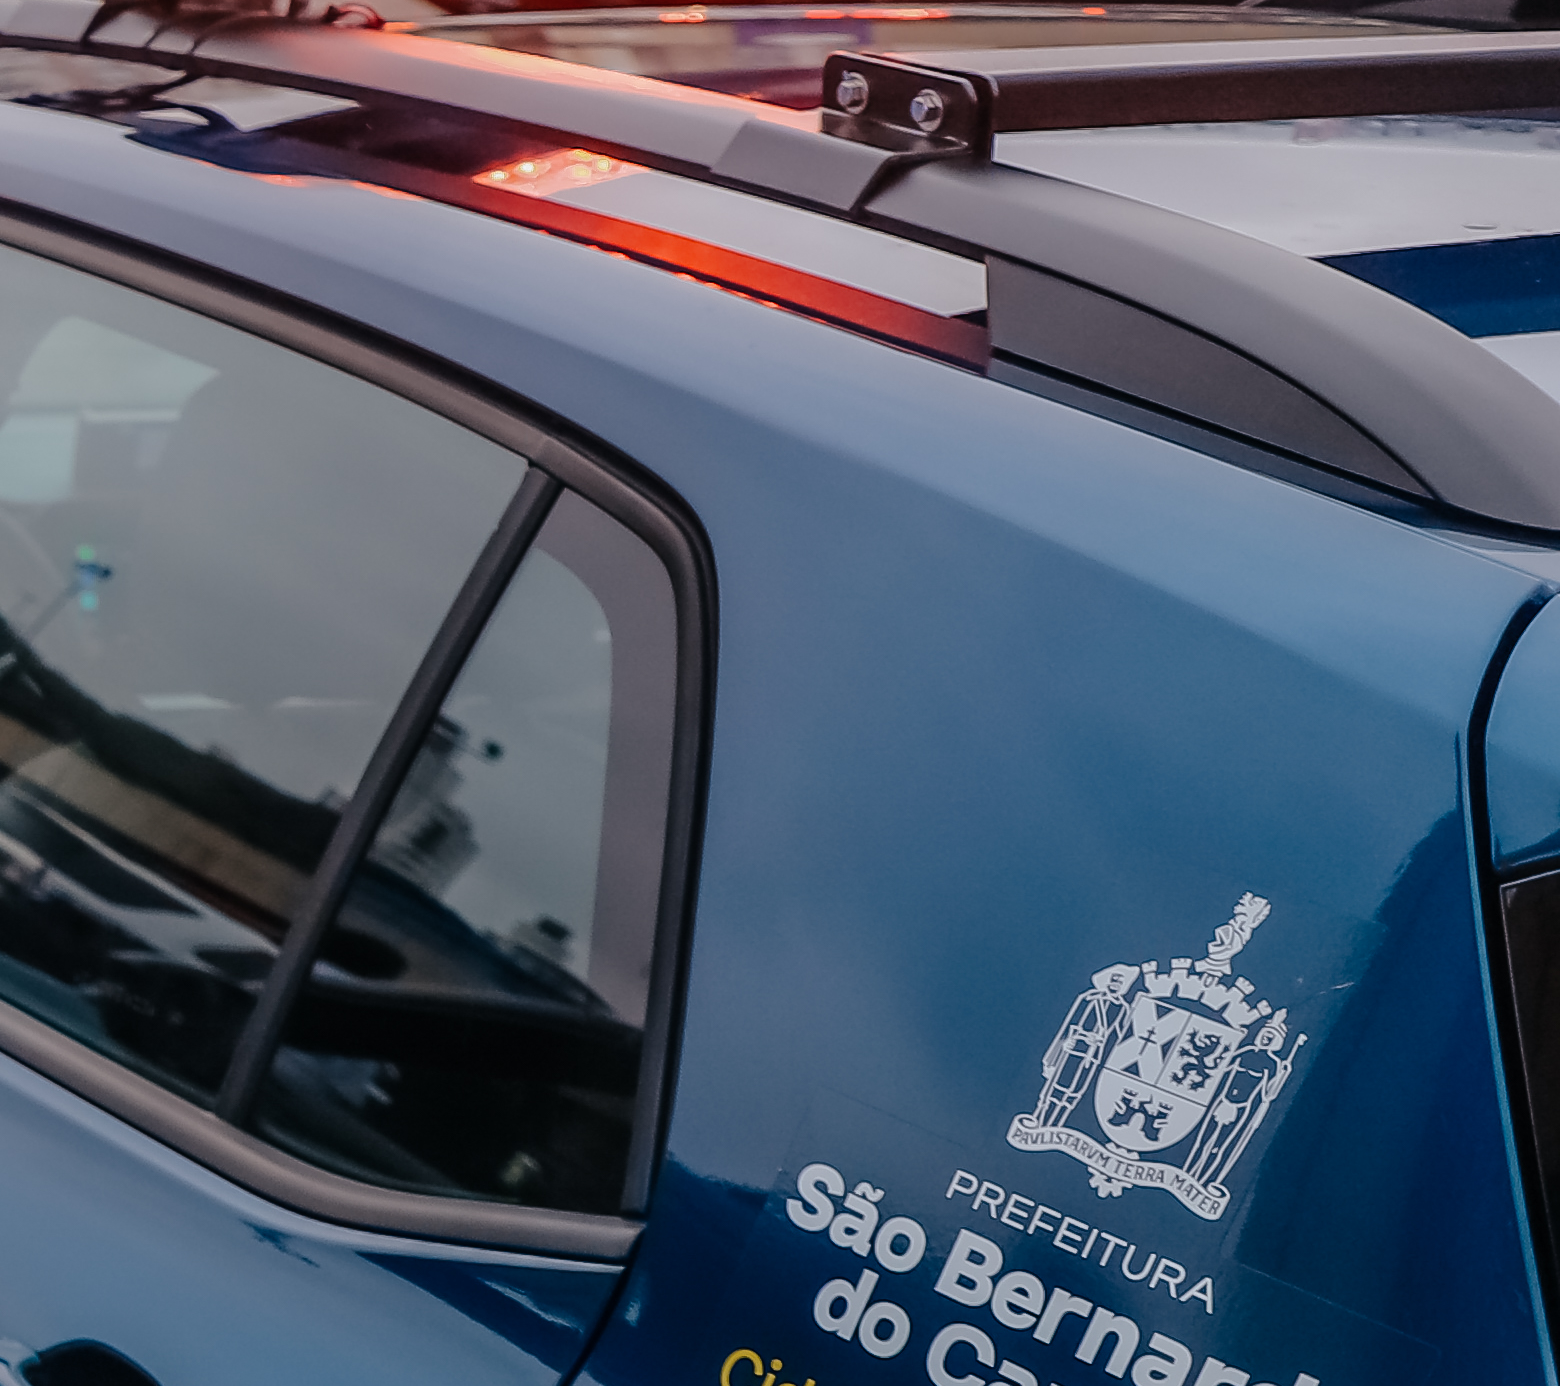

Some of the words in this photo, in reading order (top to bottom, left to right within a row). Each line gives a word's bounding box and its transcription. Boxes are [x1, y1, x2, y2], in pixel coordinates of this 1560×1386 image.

[786, 1163, 926, 1273] São
[1113, 1160, 1166, 1184] TERRA
[1170, 1173, 1221, 1215] MATER
[946, 1169, 1216, 1314] PREFEITURA
[814, 1270, 910, 1359] do
